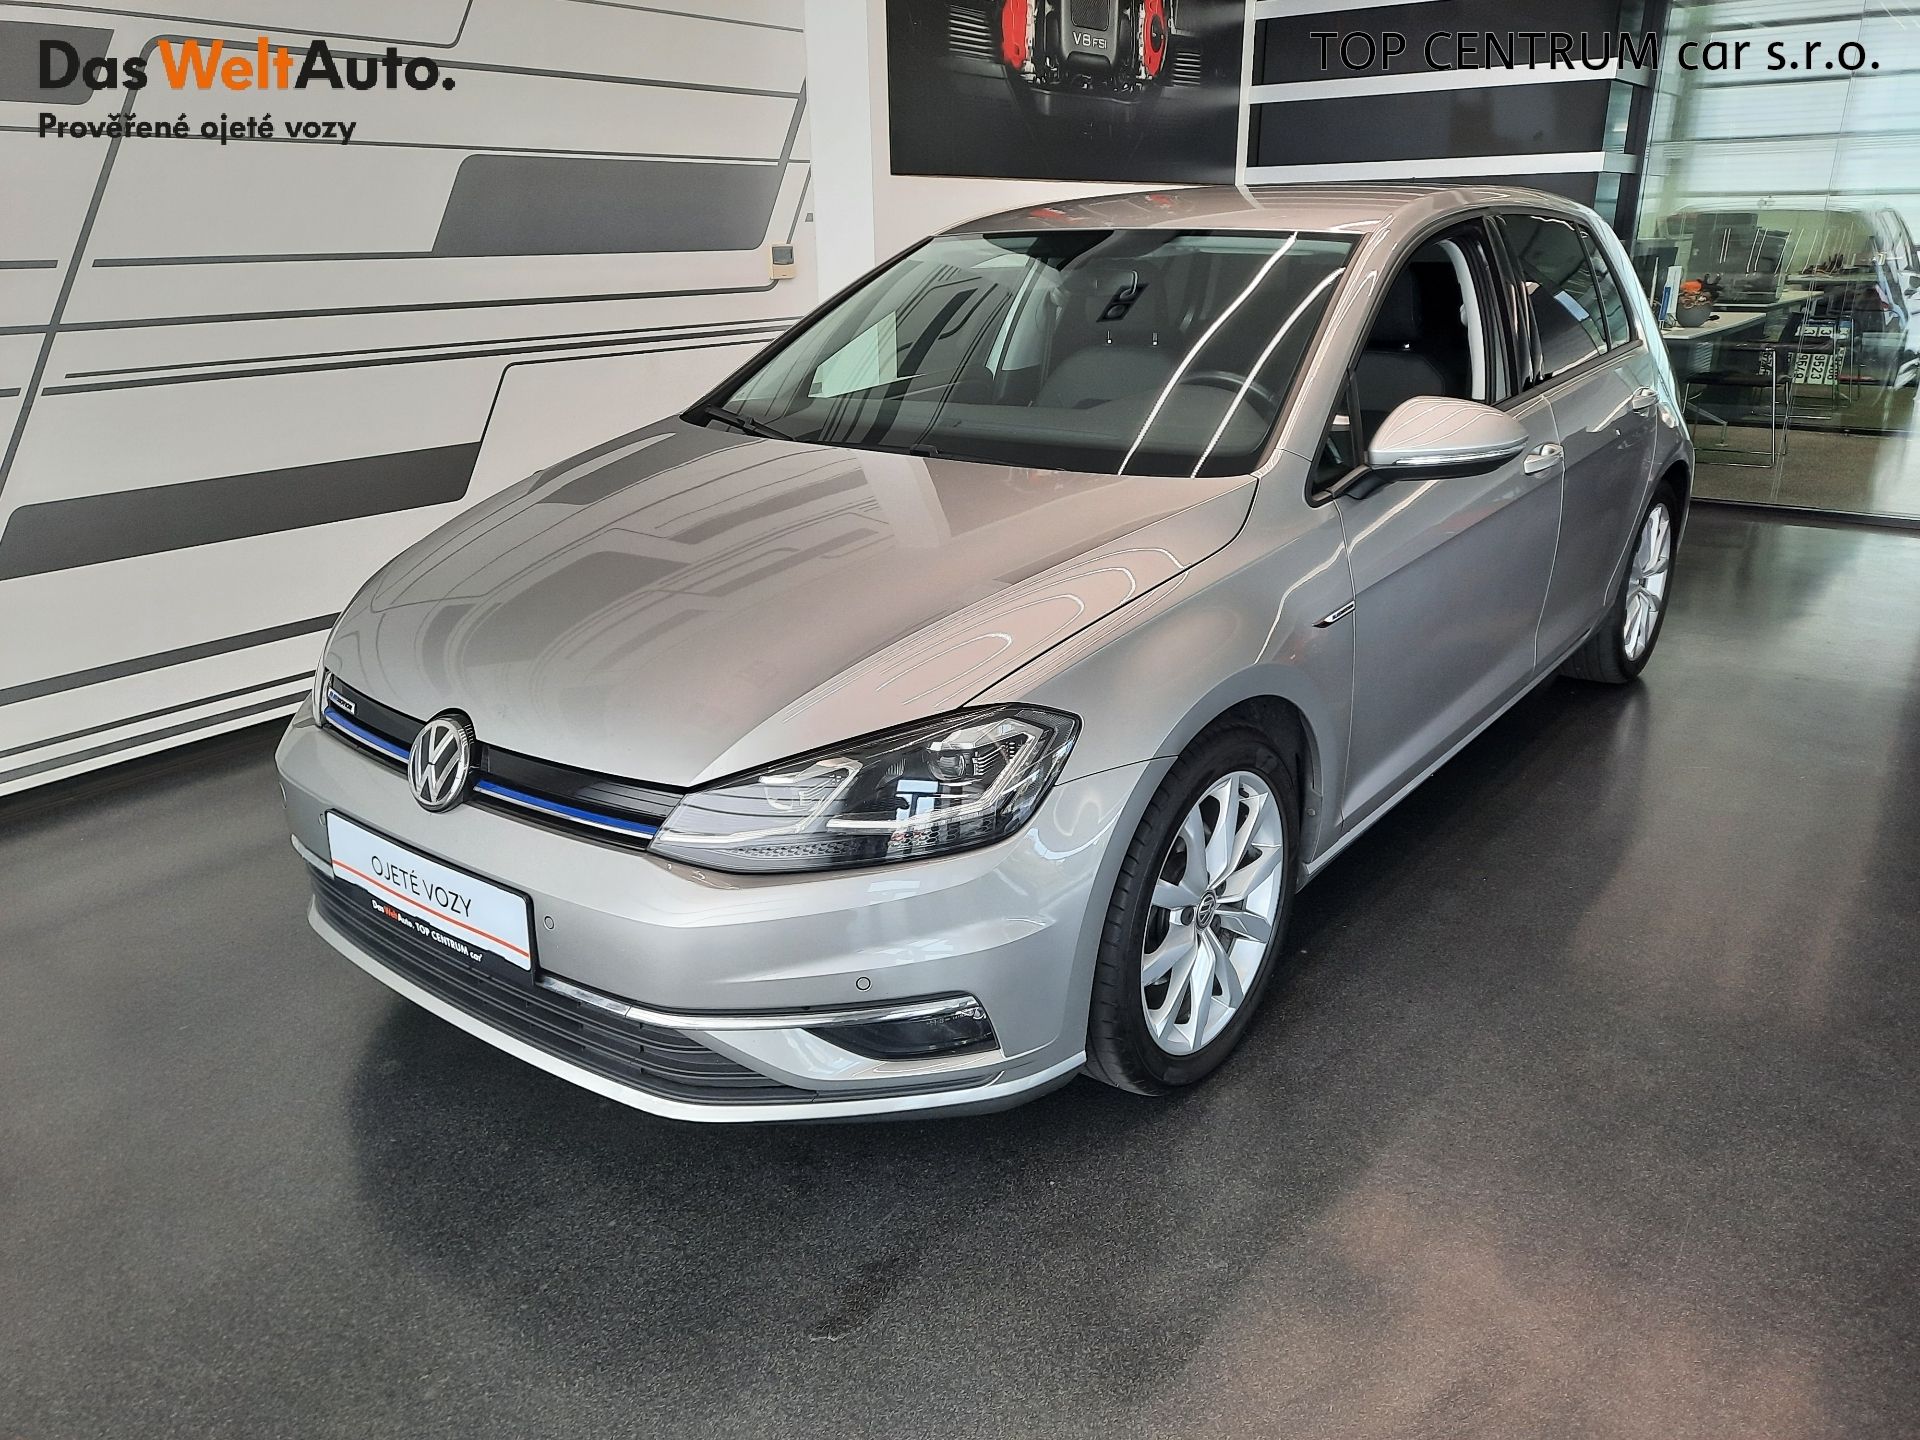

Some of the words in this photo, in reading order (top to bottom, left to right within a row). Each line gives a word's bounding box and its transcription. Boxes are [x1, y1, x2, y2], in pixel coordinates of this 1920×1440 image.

[1072, 31, 1091, 46] V8
[1092, 37, 1107, 49] FSI
[1811, 355, 1826, 380] 9523
[371, 855, 421, 896] OJETÉ
[422, 879, 472, 918] VOZY
[415, 921, 430, 937] TOP
[431, 930, 469, 956] CENTRUM
